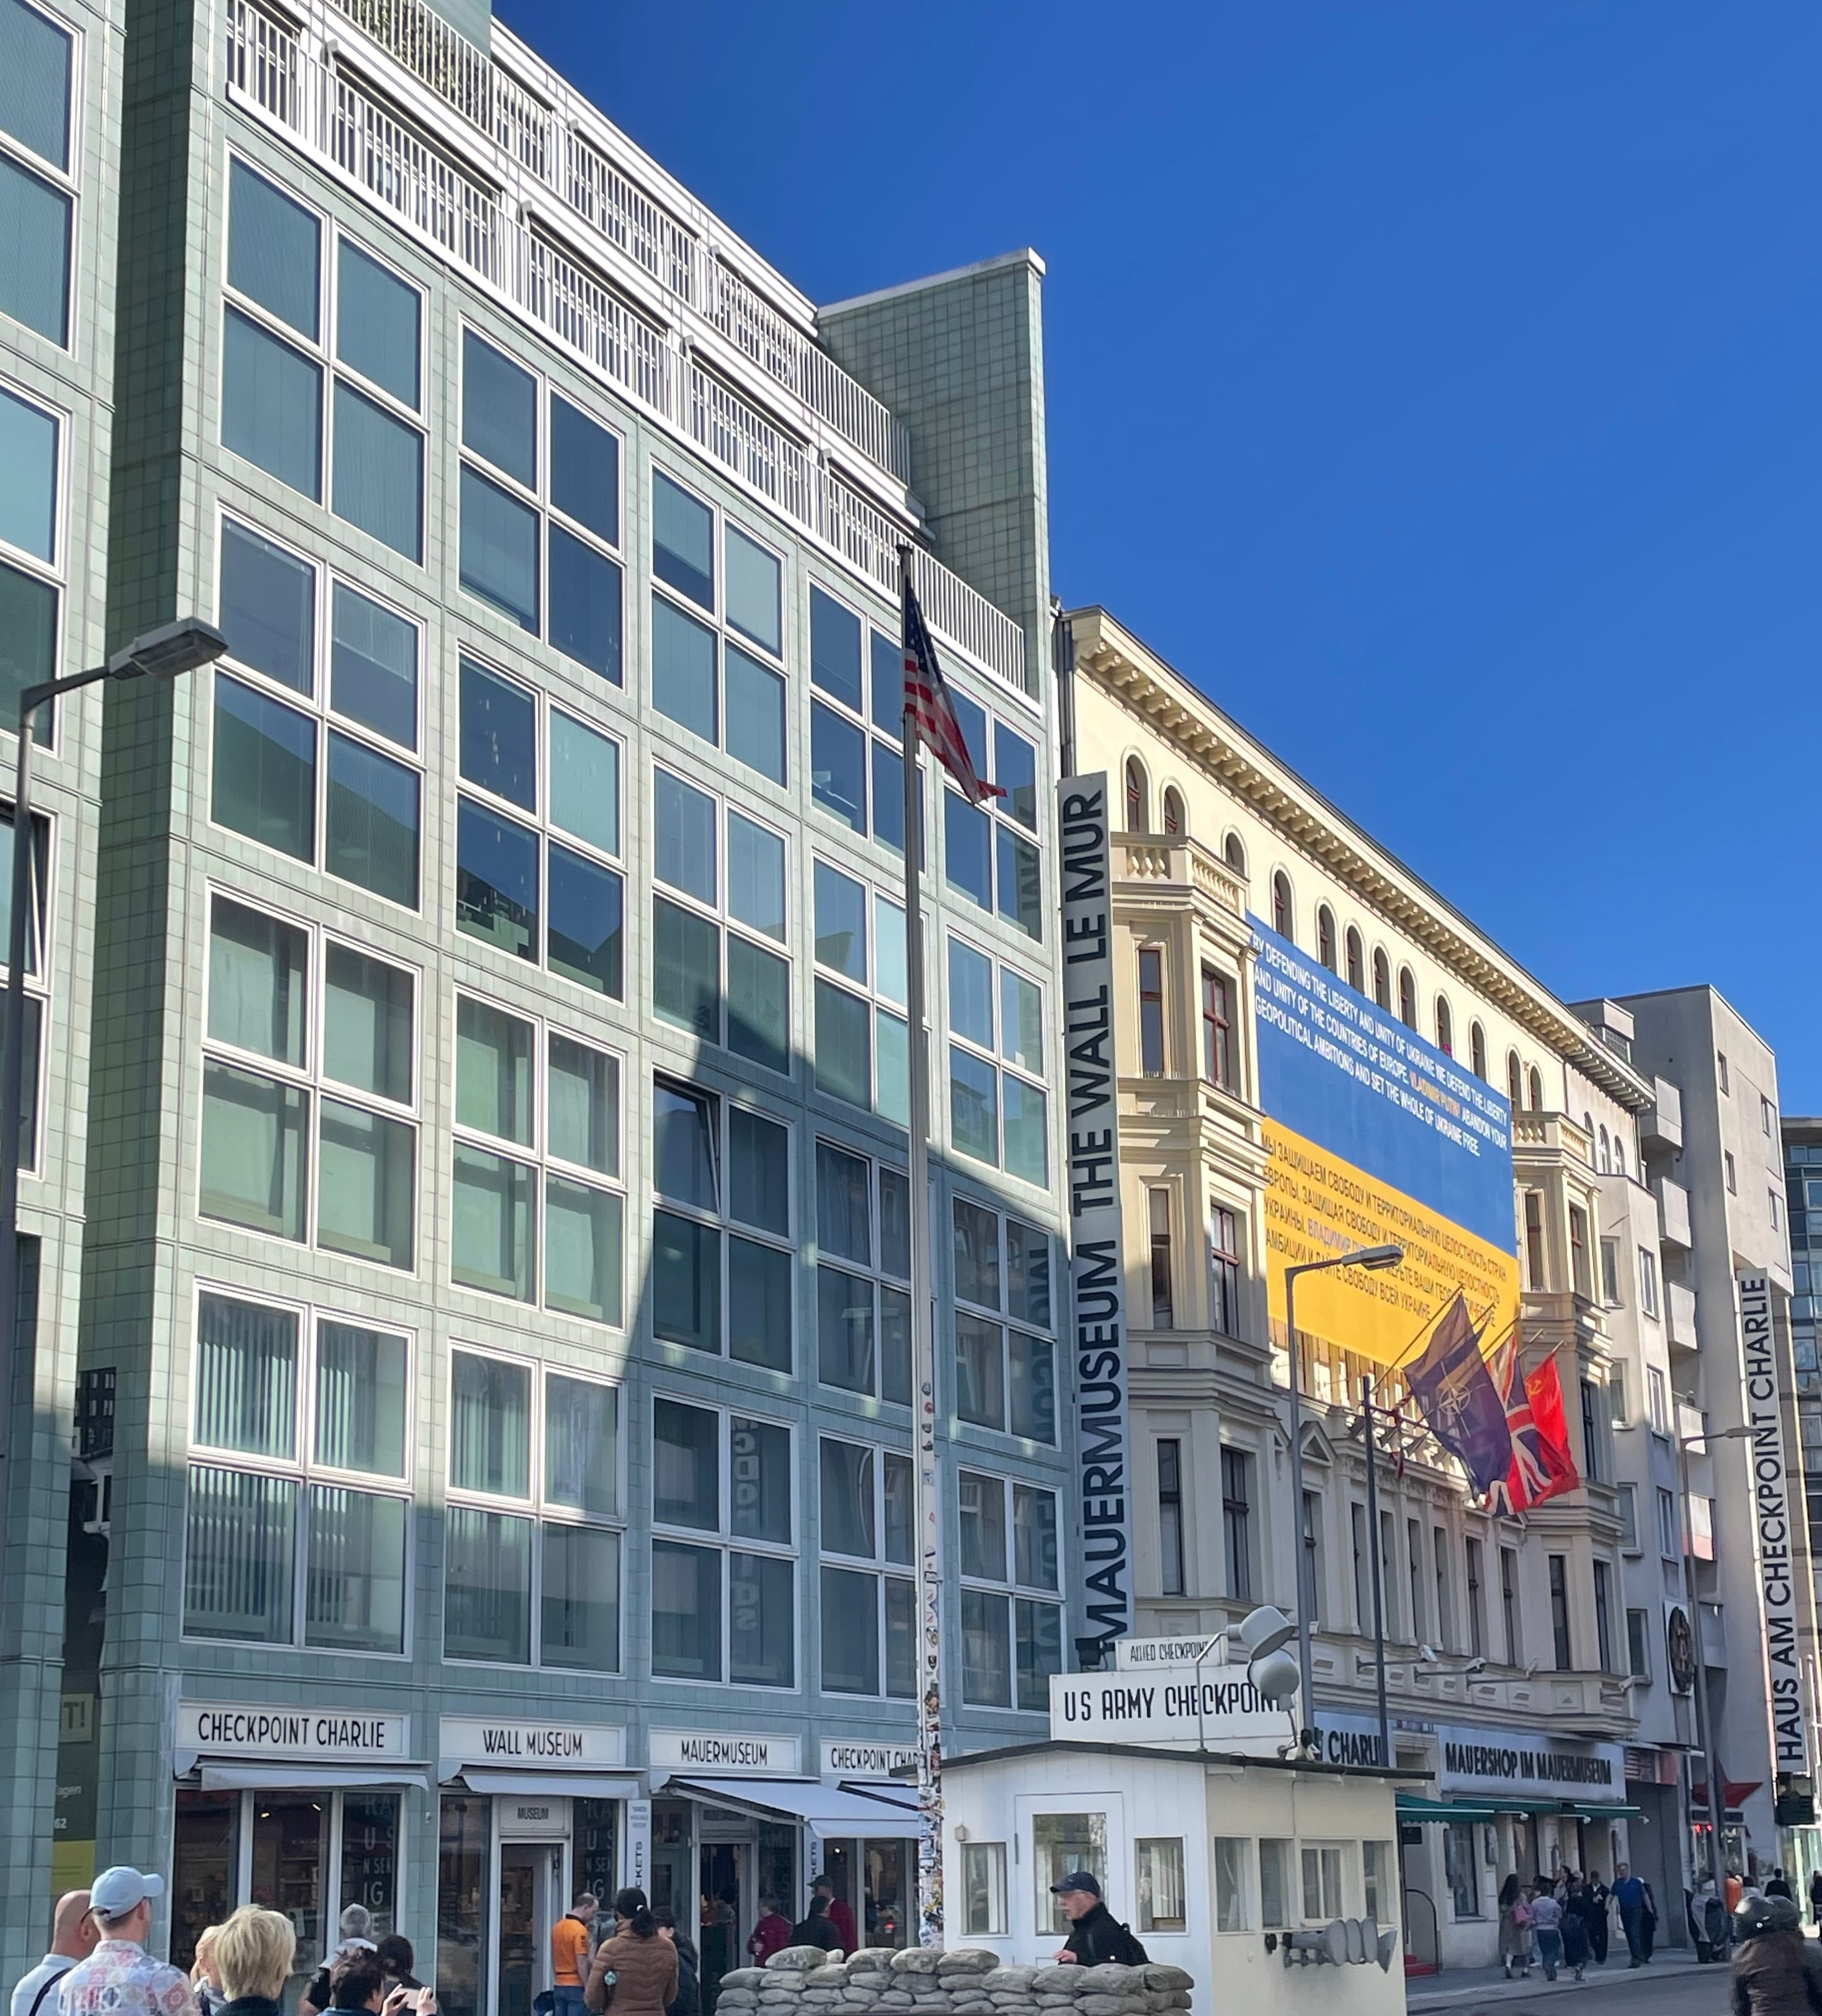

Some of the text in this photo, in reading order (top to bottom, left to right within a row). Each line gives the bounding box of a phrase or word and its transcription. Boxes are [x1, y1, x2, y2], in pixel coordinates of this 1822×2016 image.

[1254, 964, 1272, 993] AND
[1273, 976, 1296, 1010] UNITY
[1298, 995, 1308, 1016] OF
[1310, 1002, 1325, 1029] THE
[1326, 1014, 1367, 1057] COUNTRIES
[1369, 1043, 1378, 1064] OF
[1266, 943, 1311, 991] DEFENDING
[1311, 975, 1327, 1003] THE
[1328, 987, 1358, 1024] LIBERTY
[1359, 1010, 1374, 1036] AND
[1375, 1021, 1395, 1049] UNITY
[1396, 1035, 1405, 1055] OF
[1406, 1042, 1435, 1077] UKRAINE
[1435, 1062, 1447, 1085] WE
[1447, 1070, 1471, 1102] DEFEND
[1471, 1088, 1485, 1111] THE
[1483, 1097, 1507, 1127] LIBERTY
[1255, 994, 1313, 1049] GEOPOLITICAL
[1314, 1034, 1354, 1076] AMBITIONS
[1355, 1061, 1370, 1086] AND
[1371, 1072, 1385, 1095] SET
[1385, 1080, 1400, 1106] THE
[1400, 1090, 1425, 1121] WHOLE
[1425, 1106, 1434, 1126] OF
[1434, 1112, 1462, 1146] UKRAINE
[1278, 1142, 1326, 1186] ЗАЩИЩАЕМ
[1328, 1170, 1364, 1206] СВОБОДУ
[1366, 1190, 1372, 1210] И
[1063, 789, 1128, 1644] MAUERMUSEUM THE WALL LE MUR
[1346, 1207, 1380, 1245] СВОБОДУ
[1382, 1227, 1388, 1245] И
[1740, 1278, 1803, 1762] HAUS AM CHECKPOINT CHARLIE
[1065, 1691, 1091, 1721] US
[1102, 1687, 1154, 1720] ARMY
[198, 1713, 386, 1749] CHECKPOINT CHARLIE
[483, 1729, 583, 1757] WALL MUSEUM
[1328, 1730, 1382, 1766] CHARLI
[681, 1739, 768, 1766] MAUERMUSEUM
[831, 1747, 891, 1770] CHECKPOINT
[1445, 1742, 1612, 1785] MAUERSHOP IM MAUERMUSEUM
[56, 1785, 82, 1799] agen
